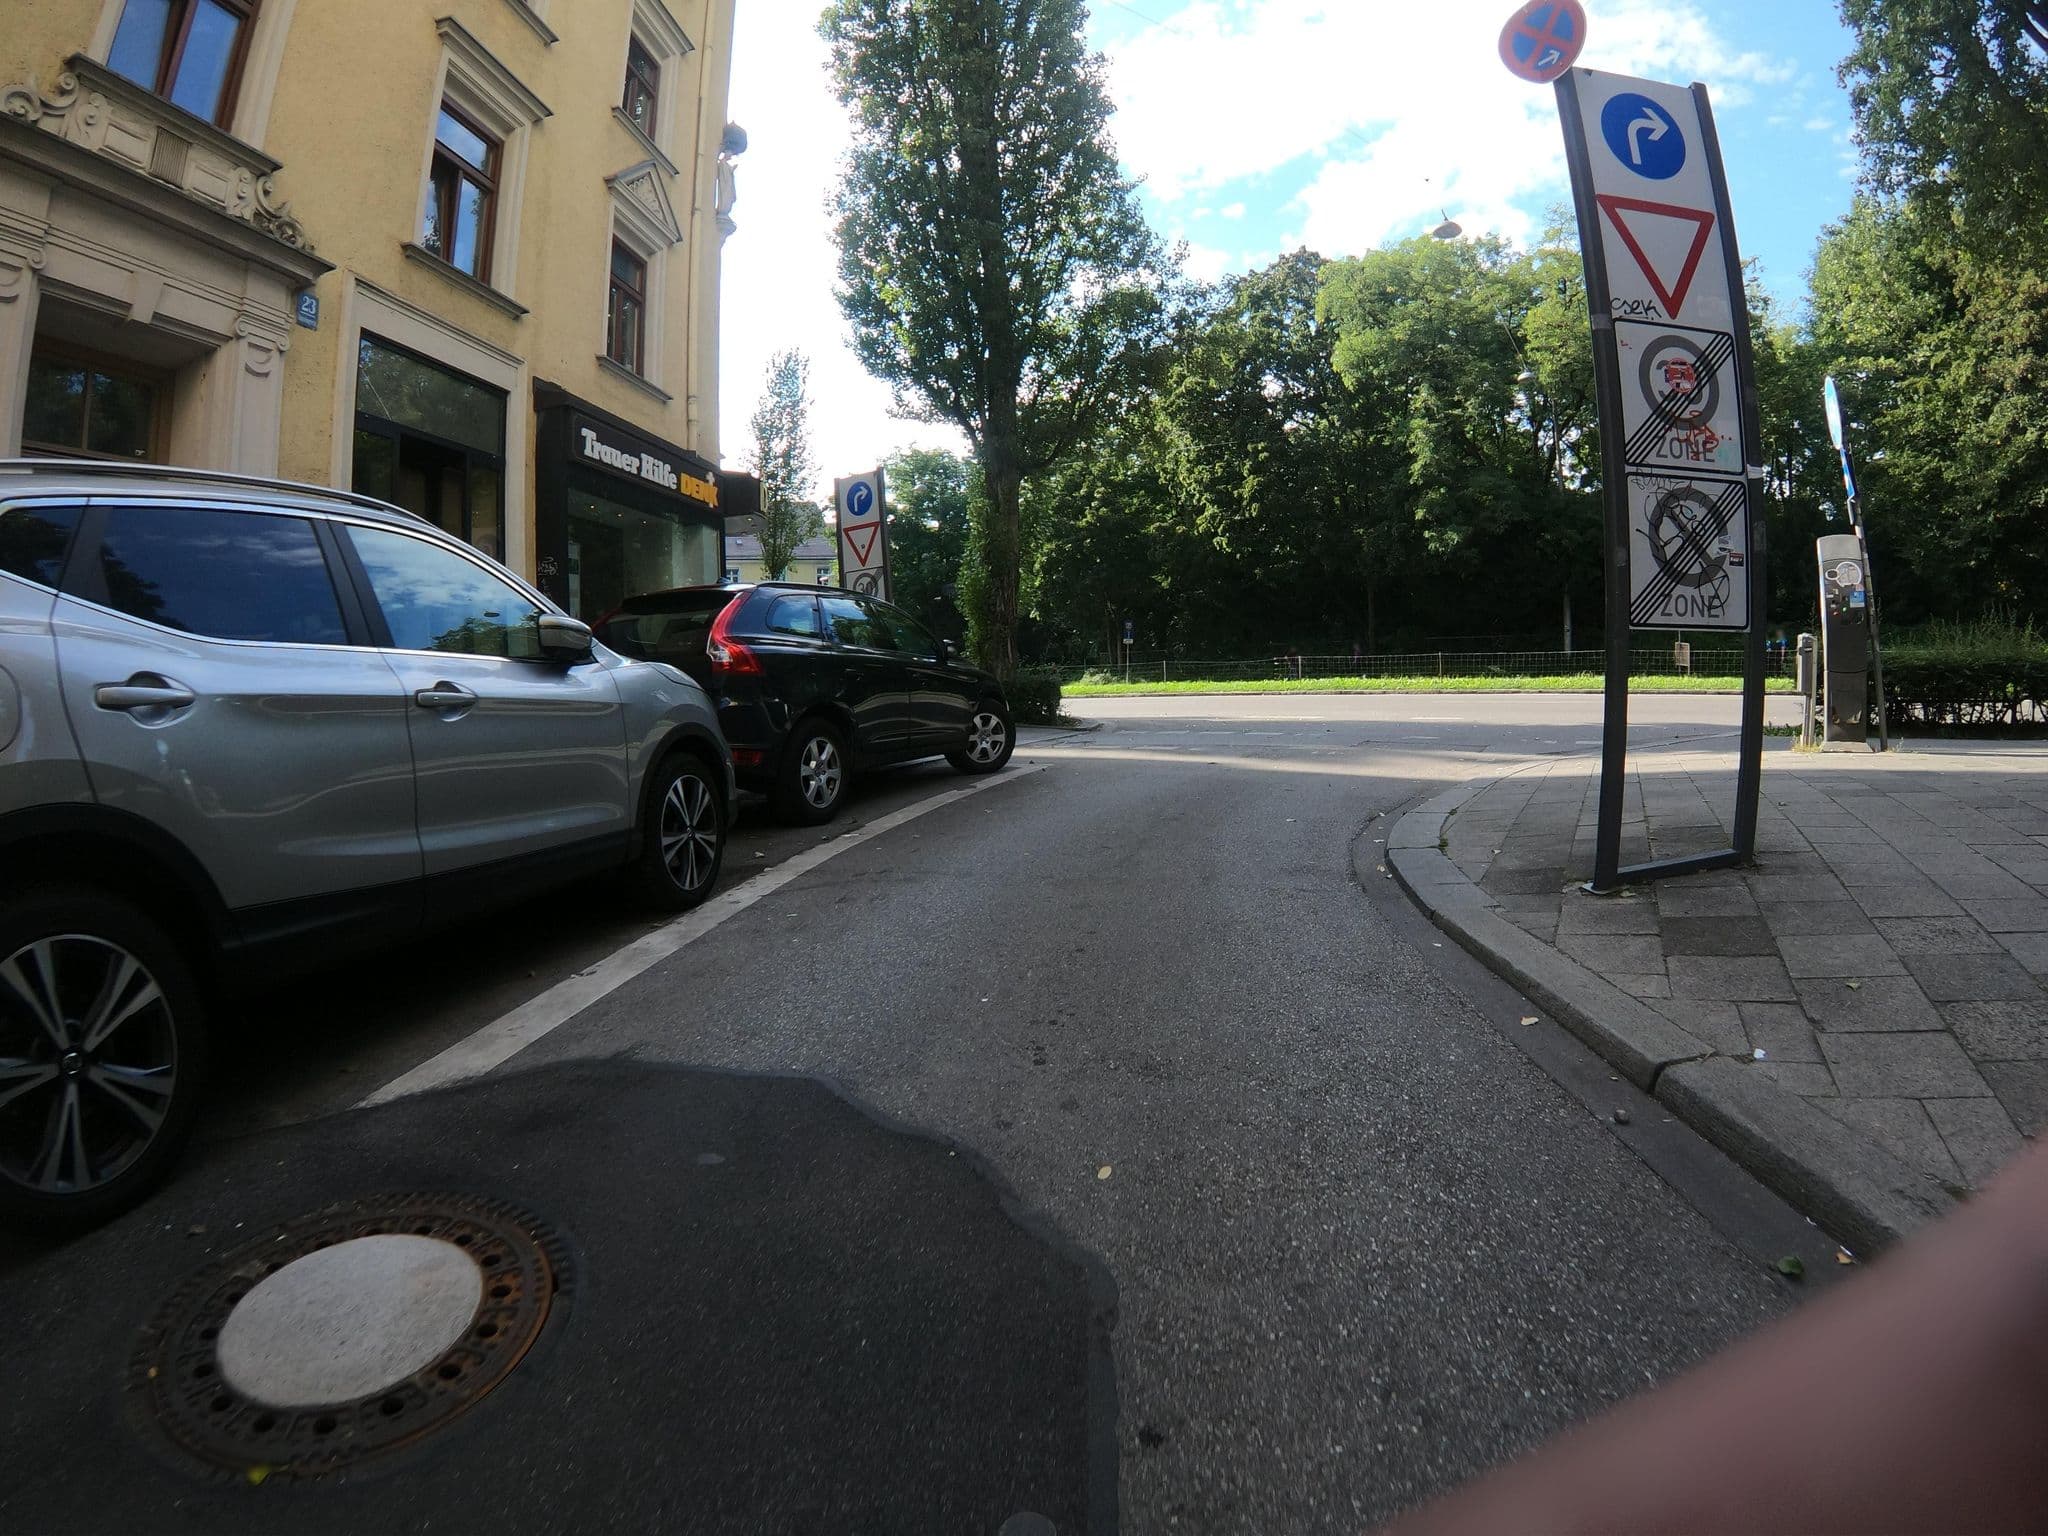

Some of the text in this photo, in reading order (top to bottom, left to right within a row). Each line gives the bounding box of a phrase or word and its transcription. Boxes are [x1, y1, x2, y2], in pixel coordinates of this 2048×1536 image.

[302, 295, 317, 314] 23
[1655, 434, 1716, 463] ZONE
[580, 427, 720, 508] Trauer Hilfe DENK
[1660, 593, 1721, 619] ZONE
